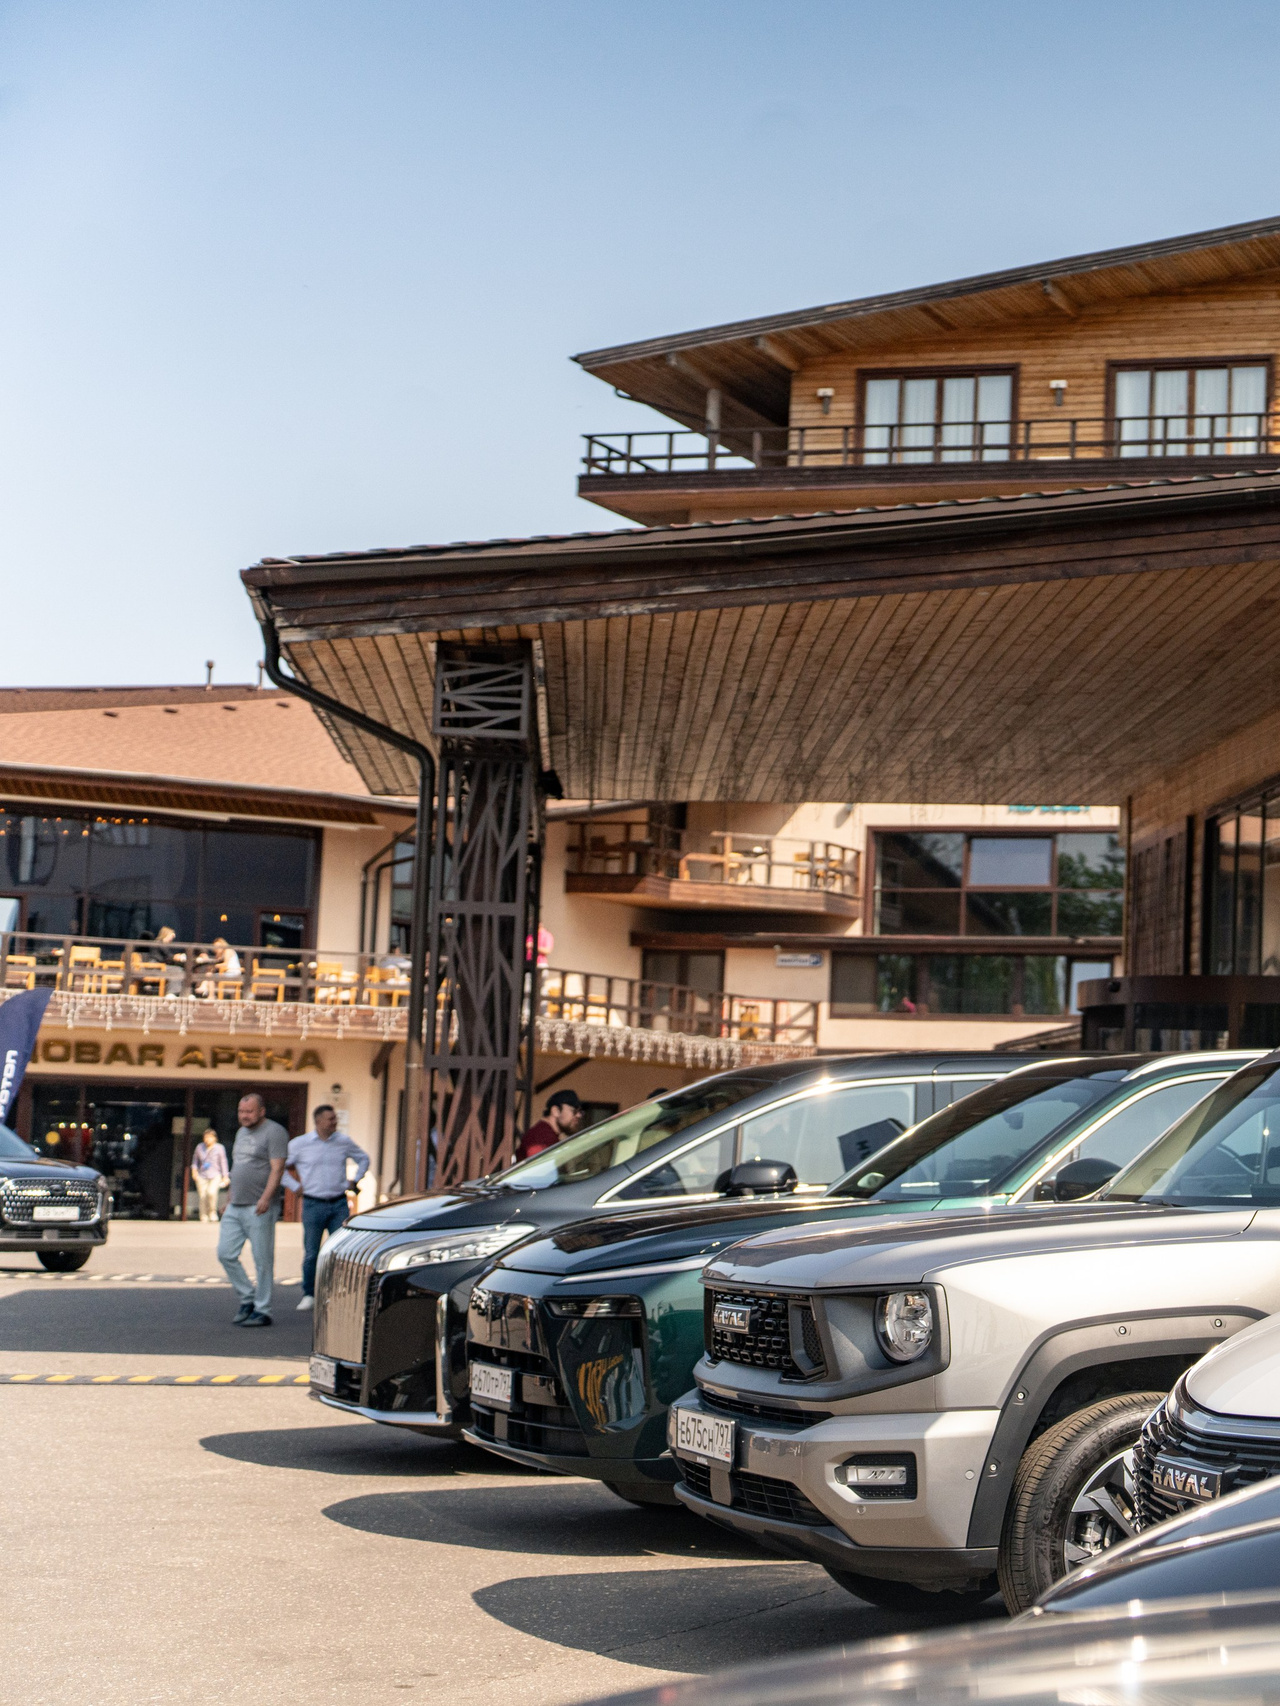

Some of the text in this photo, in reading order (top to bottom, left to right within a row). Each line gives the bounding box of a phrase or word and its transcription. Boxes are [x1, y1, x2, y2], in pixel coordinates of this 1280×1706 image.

[31, 1038, 326, 1073] ОВАЯ АРЕНА
[714, 1309, 746, 1327] HAVAL
[715, 1422, 729, 1447] 797
[1152, 1463, 1214, 1498] HAVAL
